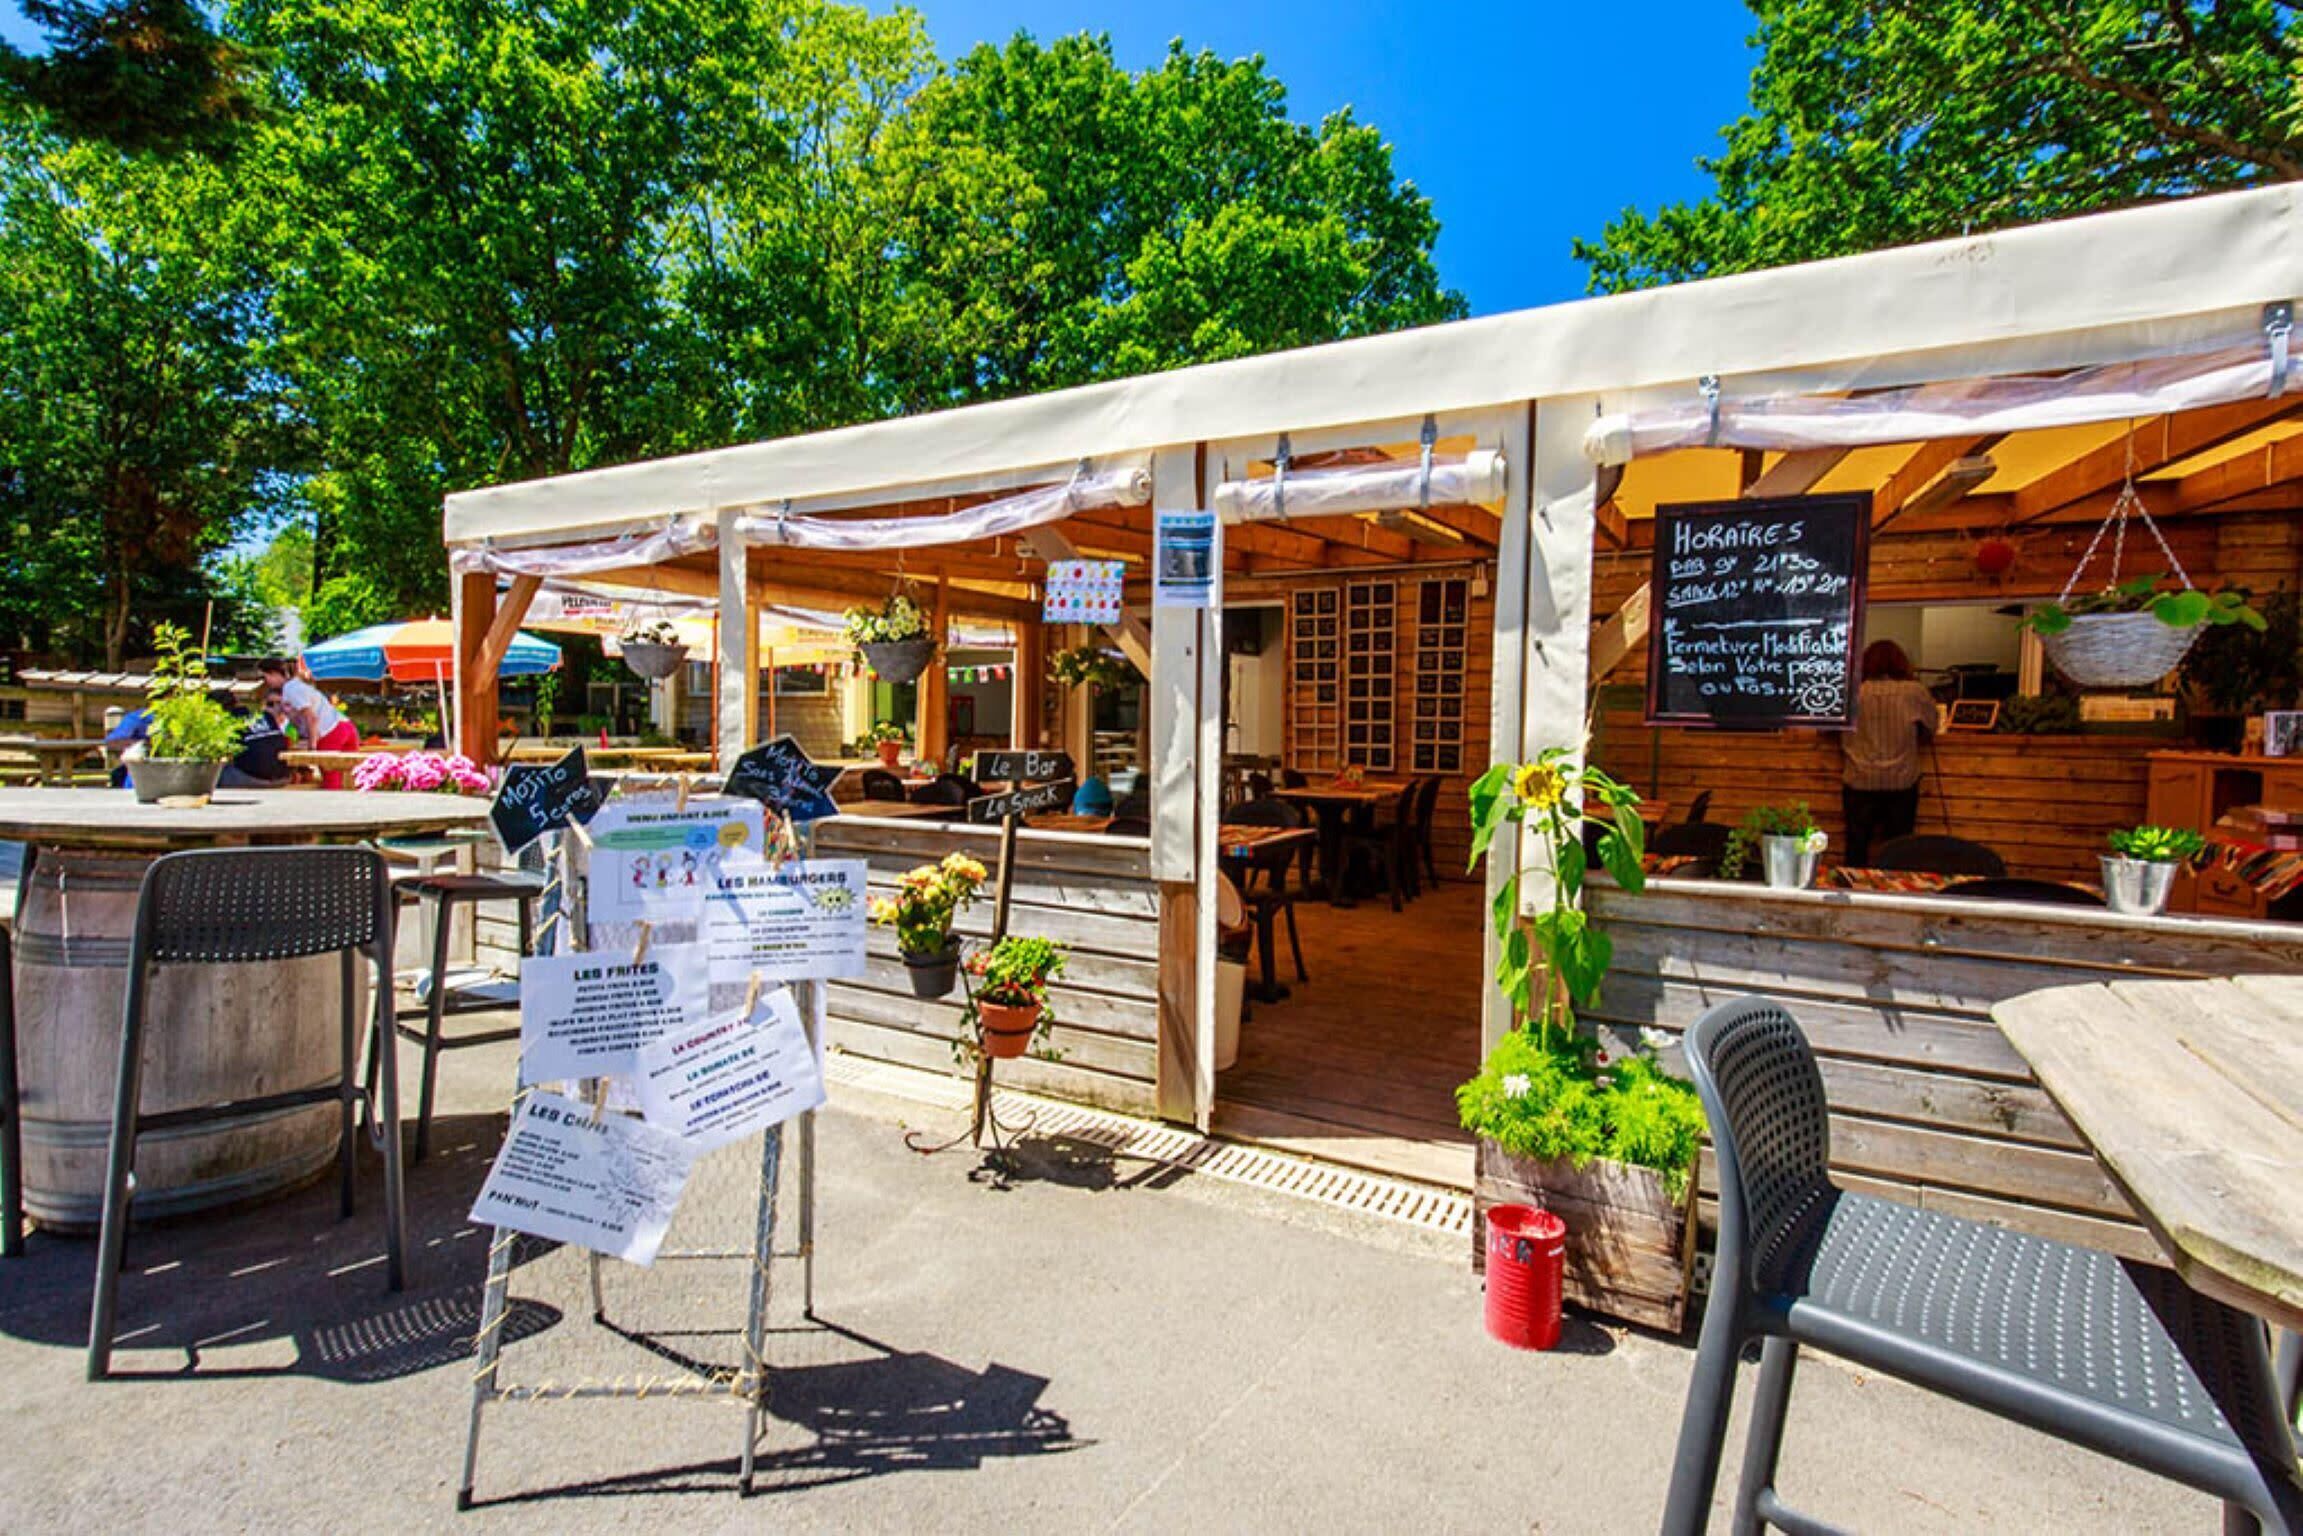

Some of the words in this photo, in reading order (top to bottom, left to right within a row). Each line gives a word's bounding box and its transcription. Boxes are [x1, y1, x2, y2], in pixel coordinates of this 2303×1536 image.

[1026, 752, 1057, 777] Bar
[748, 871, 847, 887] HAMBURGERS
[574, 968, 602, 981] LES
[607, 961, 659, 979] FRITES
[529, 1103, 560, 1122] LES
